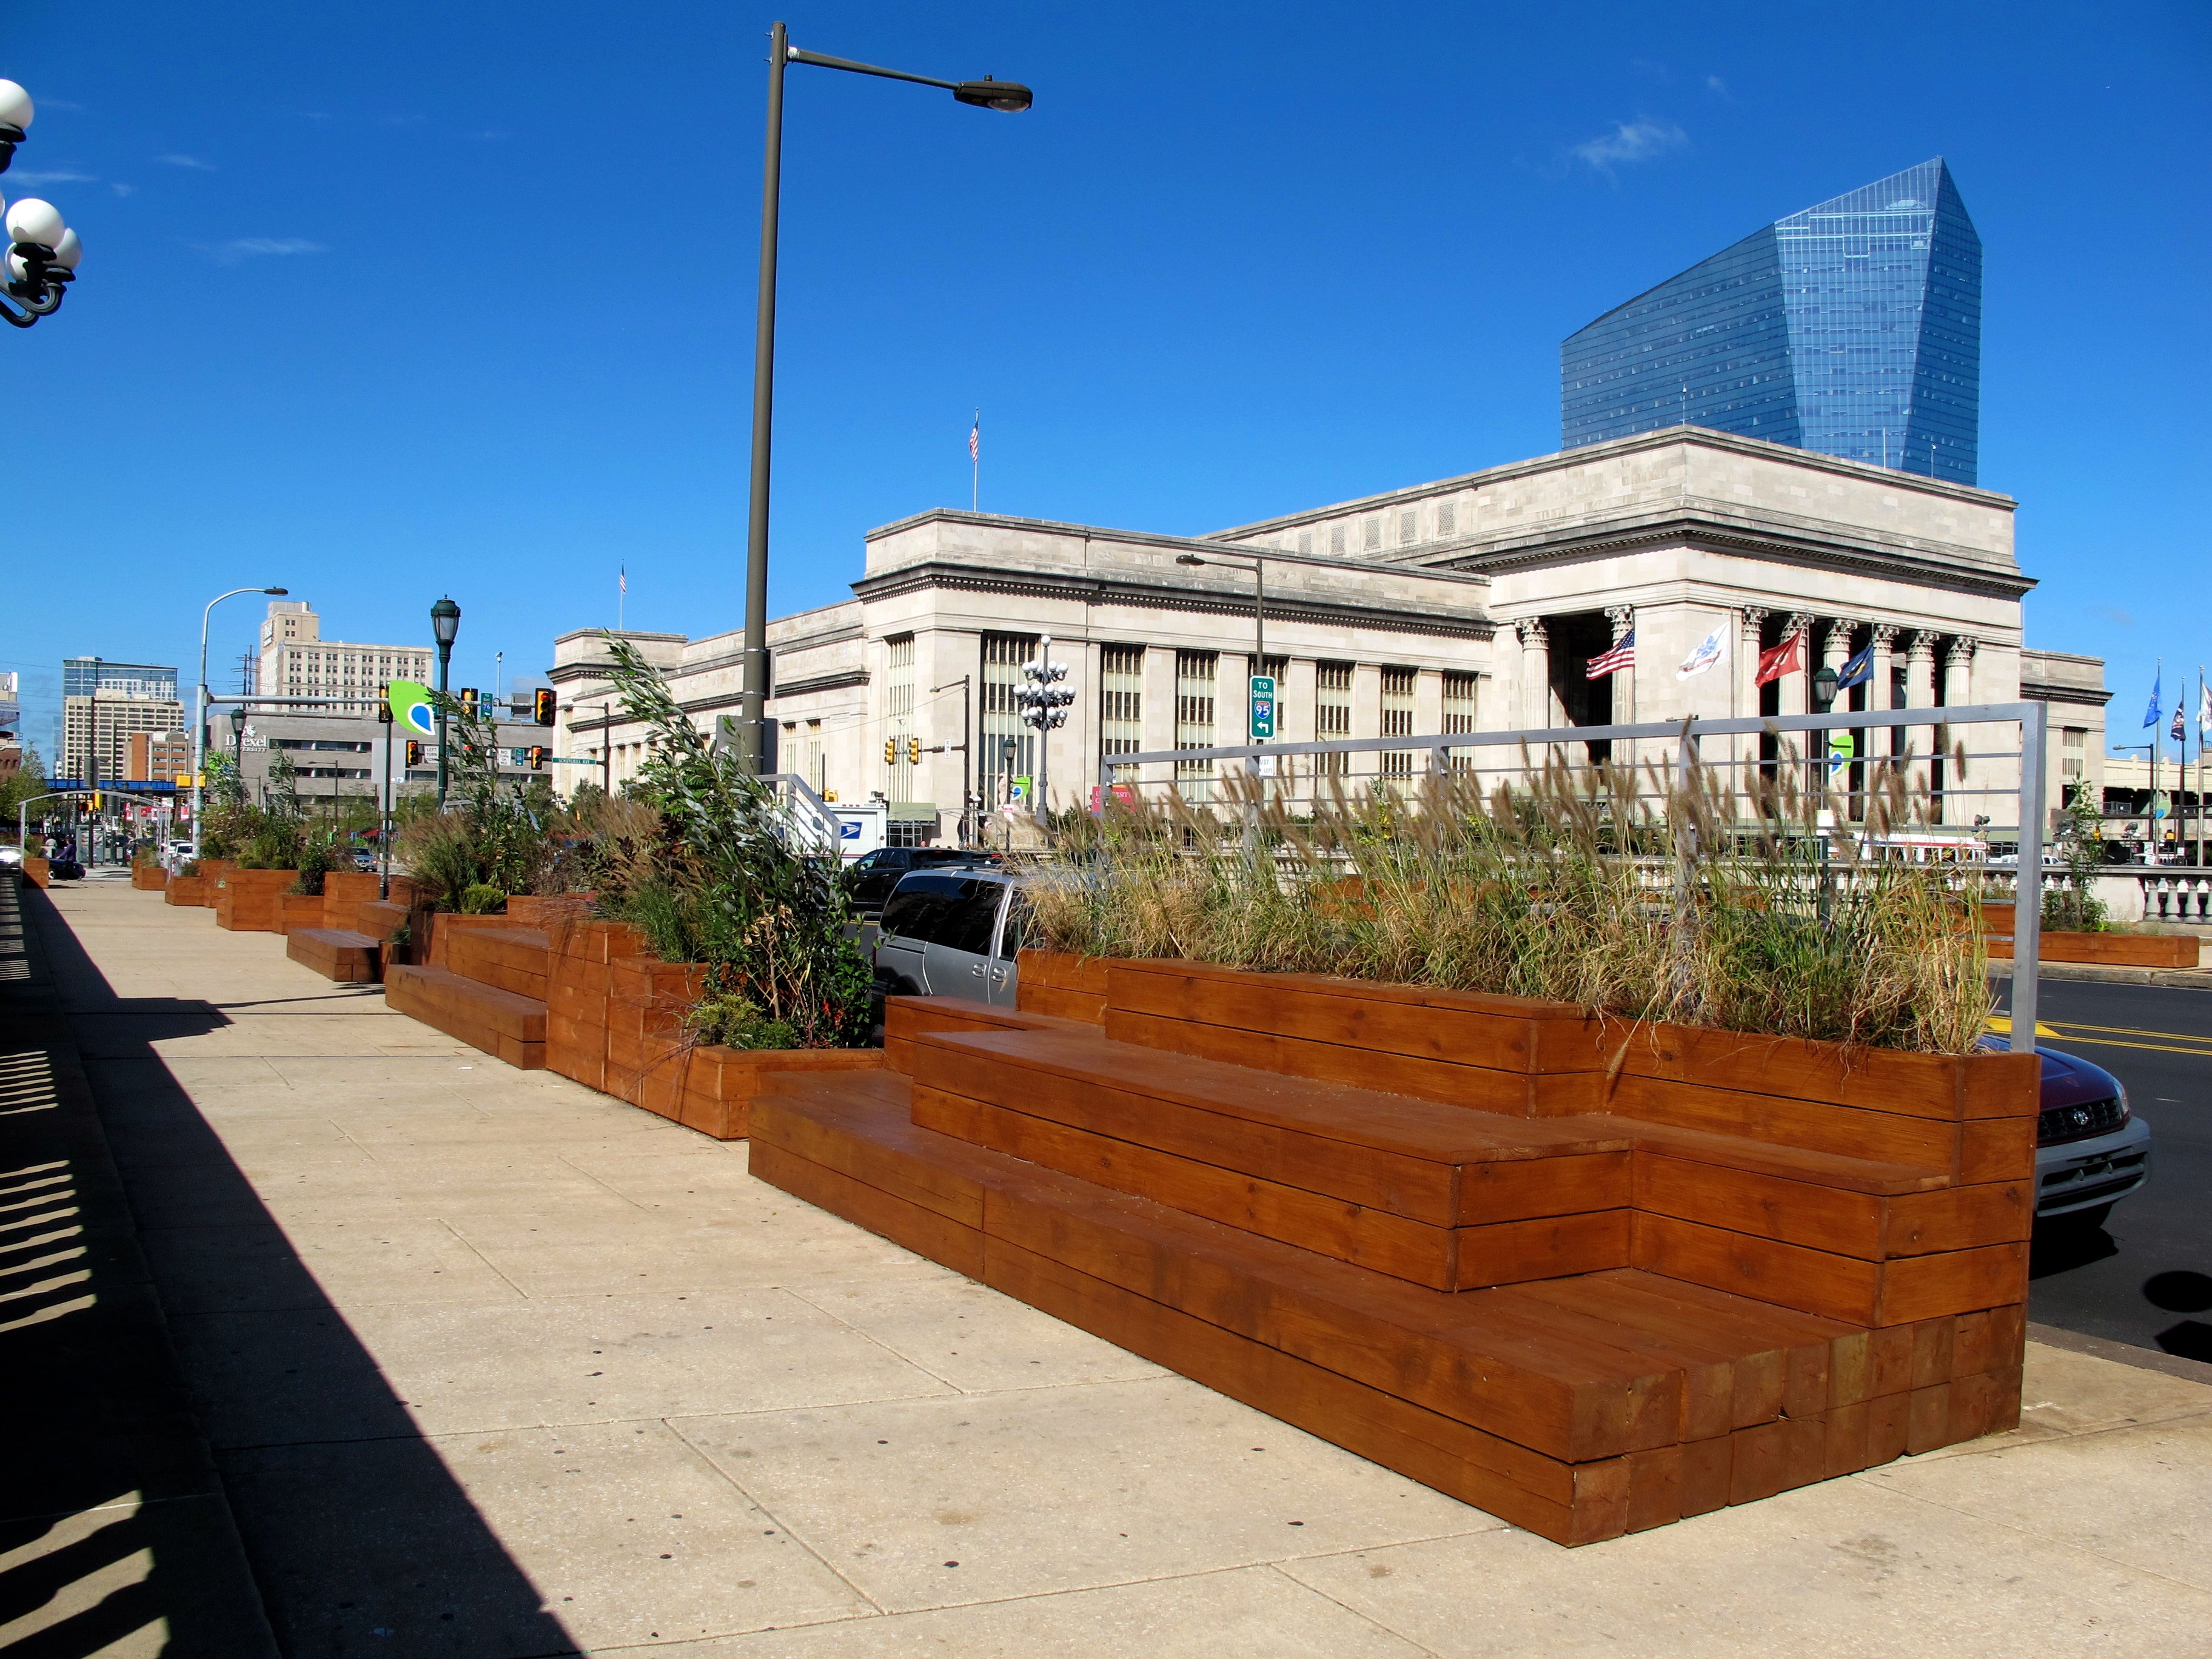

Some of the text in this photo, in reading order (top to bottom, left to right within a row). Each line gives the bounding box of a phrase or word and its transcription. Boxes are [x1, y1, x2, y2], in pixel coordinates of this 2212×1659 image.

[1253, 690, 1273, 699] SOUTH
[1256, 705, 1269, 716] 95
[225, 734, 267, 747] Dexel
